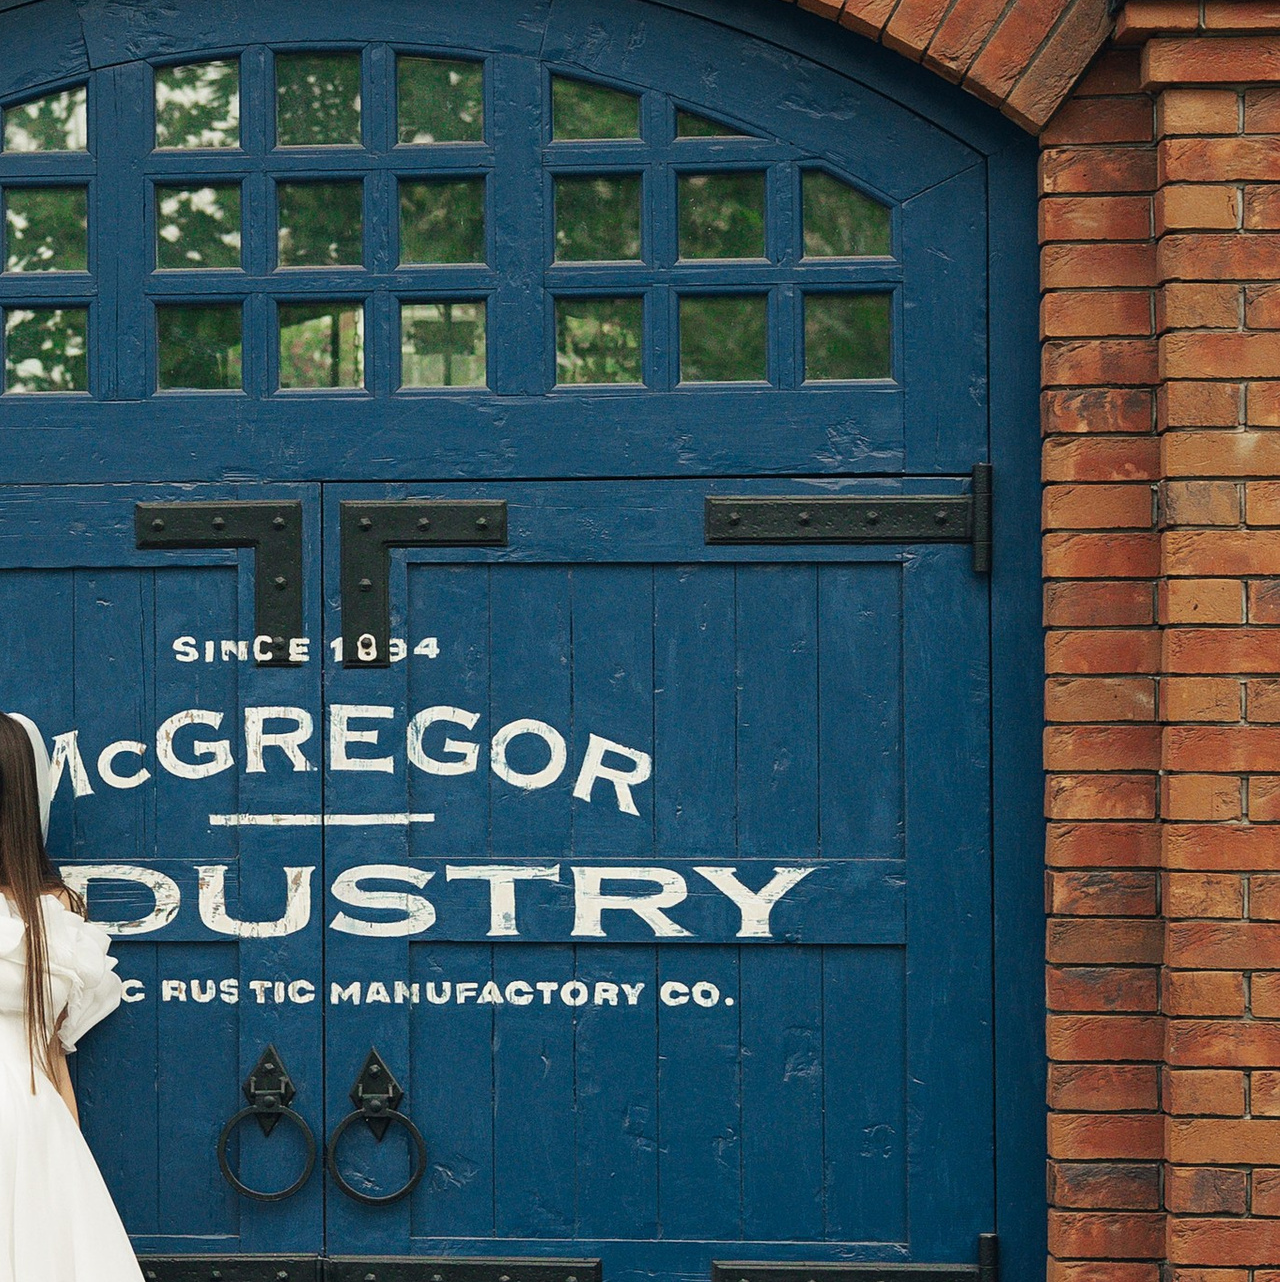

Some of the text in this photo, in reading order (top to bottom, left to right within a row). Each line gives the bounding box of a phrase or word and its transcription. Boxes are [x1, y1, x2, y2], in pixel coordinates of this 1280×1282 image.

[172, 634, 310, 663] SINCE
[161, 978, 316, 1005] RUSTIC
[330, 979, 645, 1007] MANUFACTORY
[659, 980, 734, 1008] CO.
